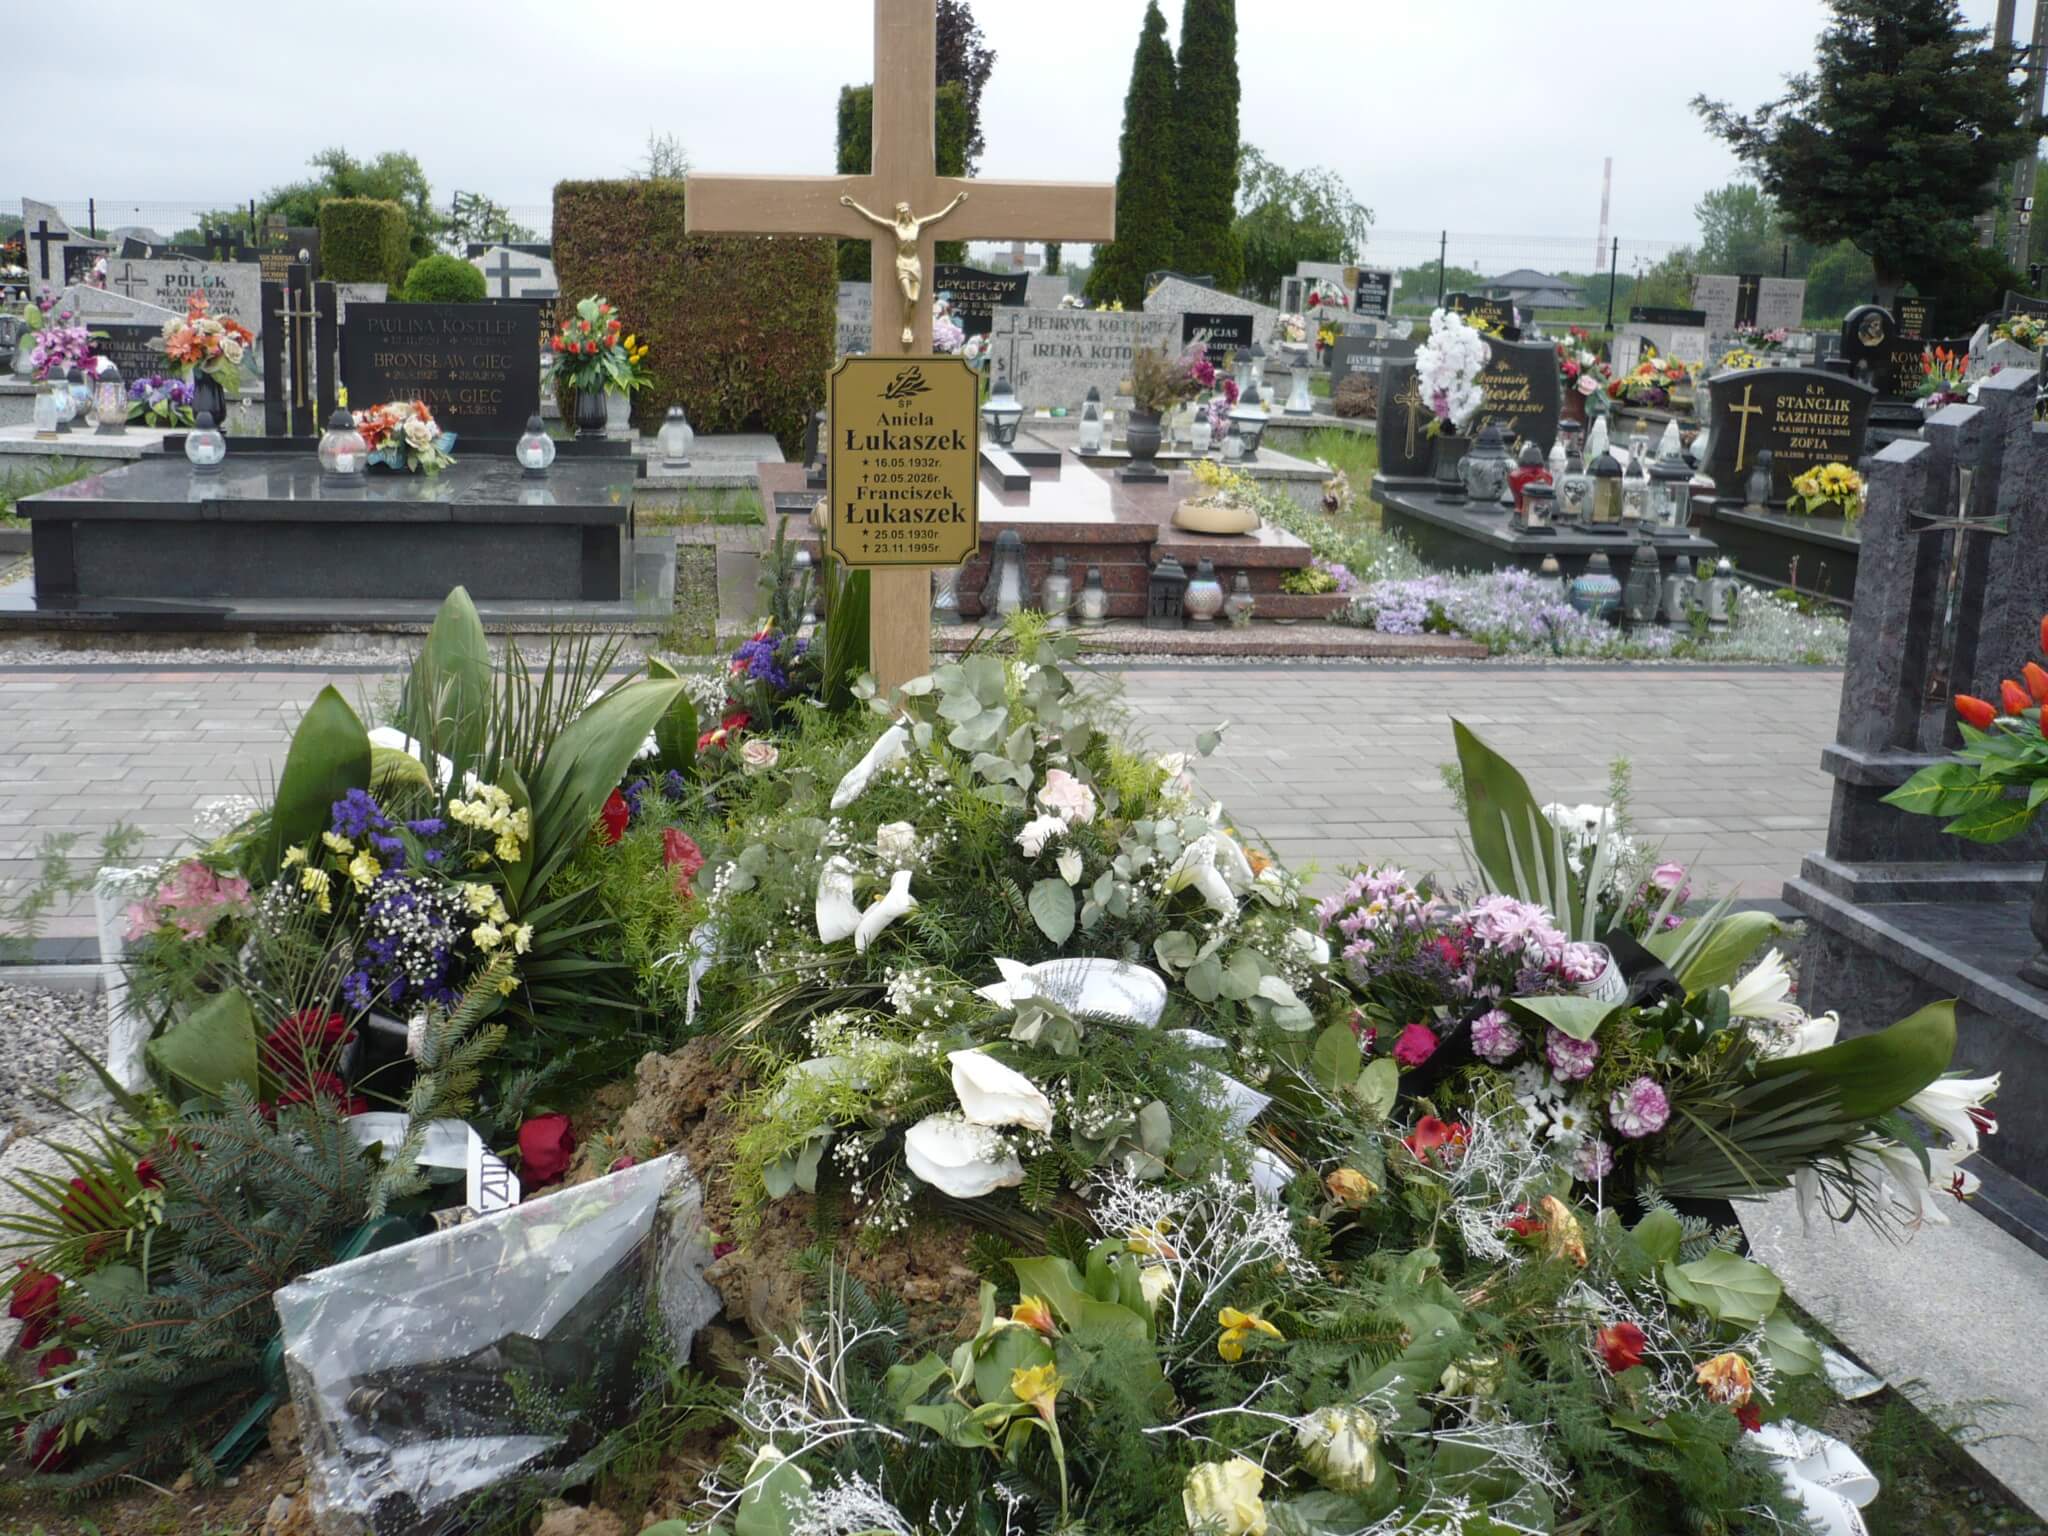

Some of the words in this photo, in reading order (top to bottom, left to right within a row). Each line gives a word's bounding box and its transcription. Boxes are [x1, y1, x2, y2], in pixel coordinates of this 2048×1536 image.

[368, 319, 433, 333] PAULINA
[1028, 316, 1091, 331] HENRYK
[473, 354, 513, 368] GIEC
[460, 389, 502, 404] GIEC
[1776, 396, 1850, 411] STANCLIK
[876, 412, 934, 426] Aniela
[1776, 411, 1849, 425] KAZIMIERZ
[846, 429, 966, 451] Łukaszek
[1790, 437, 1828, 449] ZOFIA
[856, 486, 953, 500] Franciszek
[846, 502, 966, 524] Łukaszek
